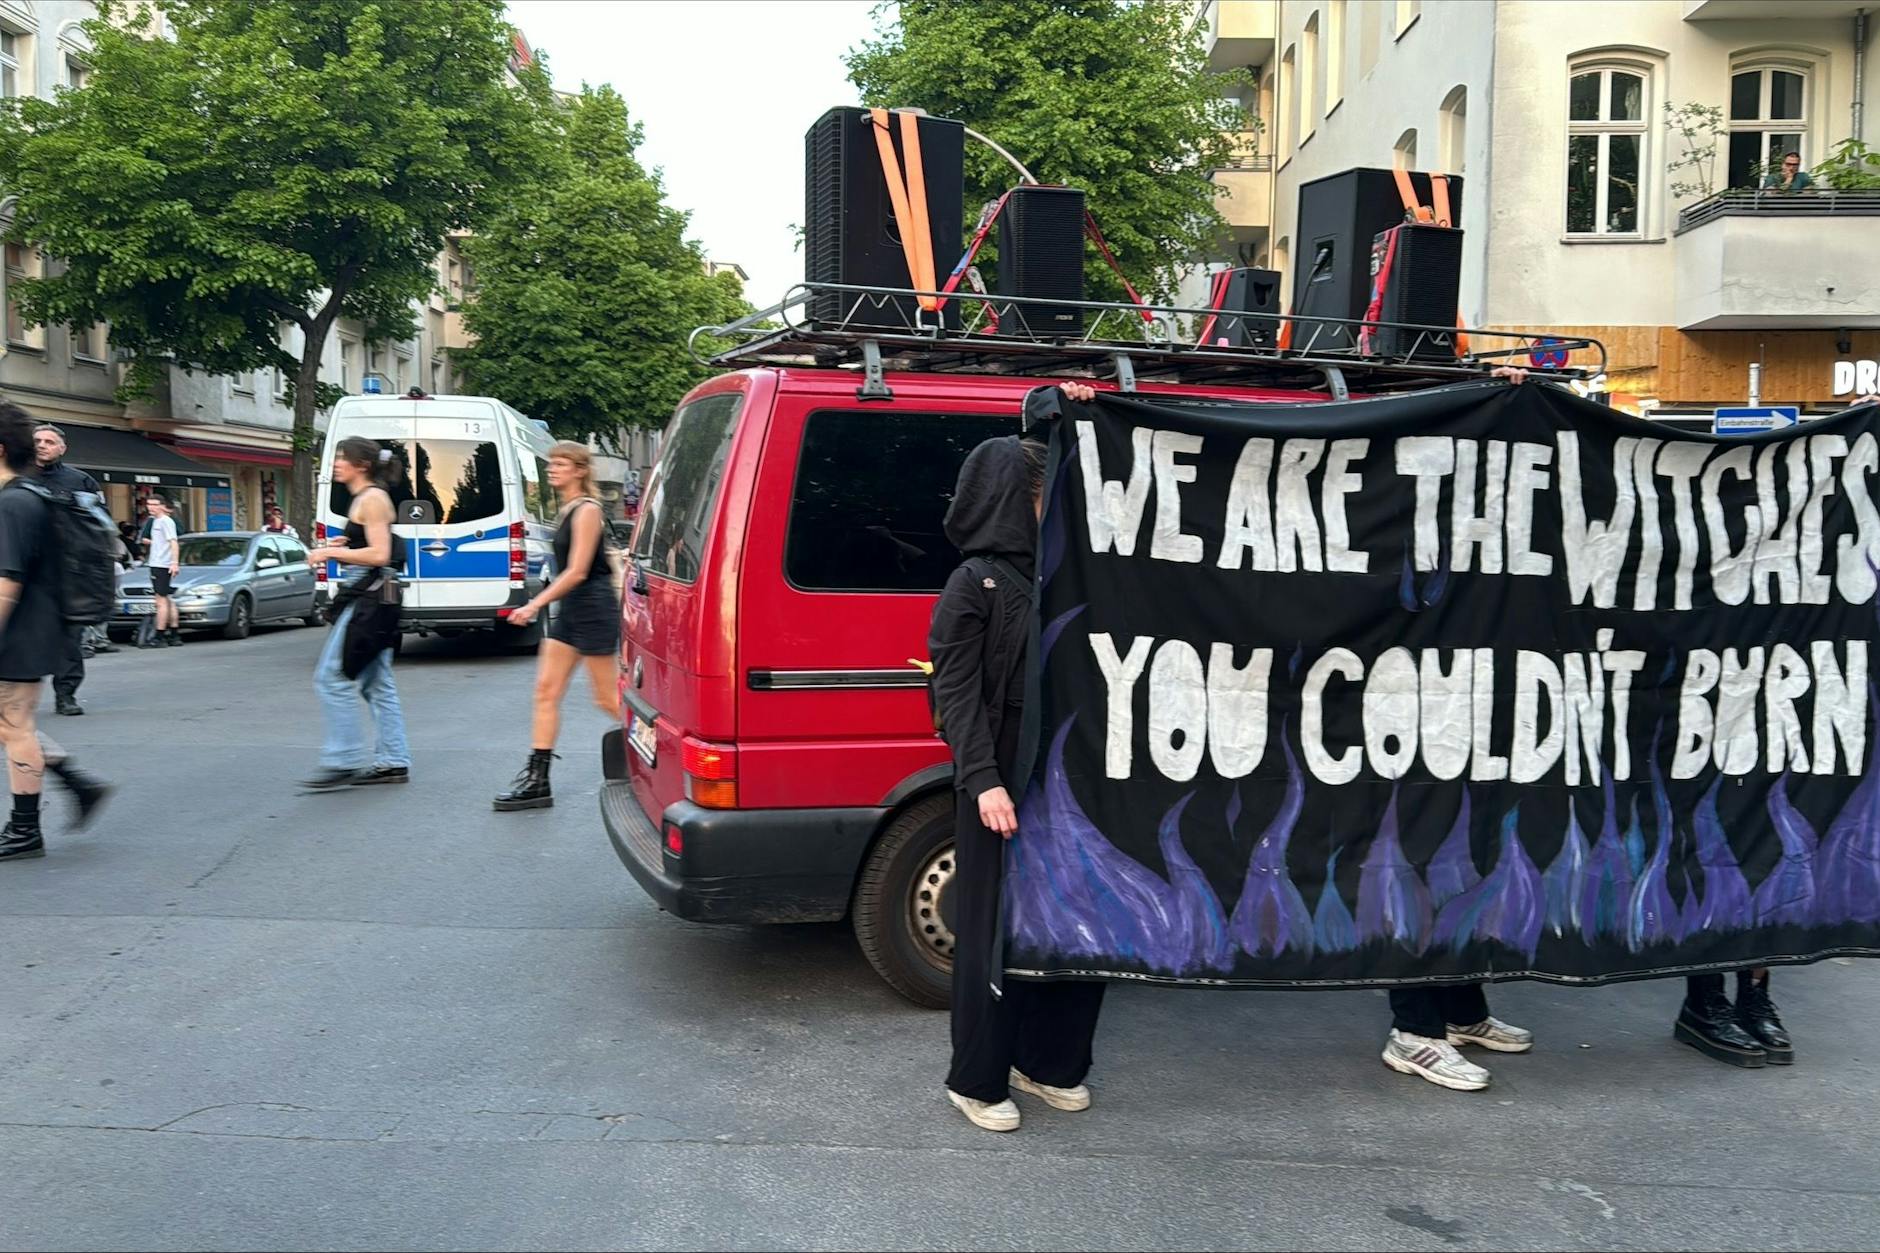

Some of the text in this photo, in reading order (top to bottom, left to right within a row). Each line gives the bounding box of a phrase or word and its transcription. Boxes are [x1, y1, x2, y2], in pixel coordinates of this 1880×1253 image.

[1834, 359, 1880, 396] DR
[464, 422, 480, 434] 13
[1075, 420, 1880, 611] WE ARE THE WITCHES
[1088, 628, 1868, 787] YOU COULDN'T BURN
